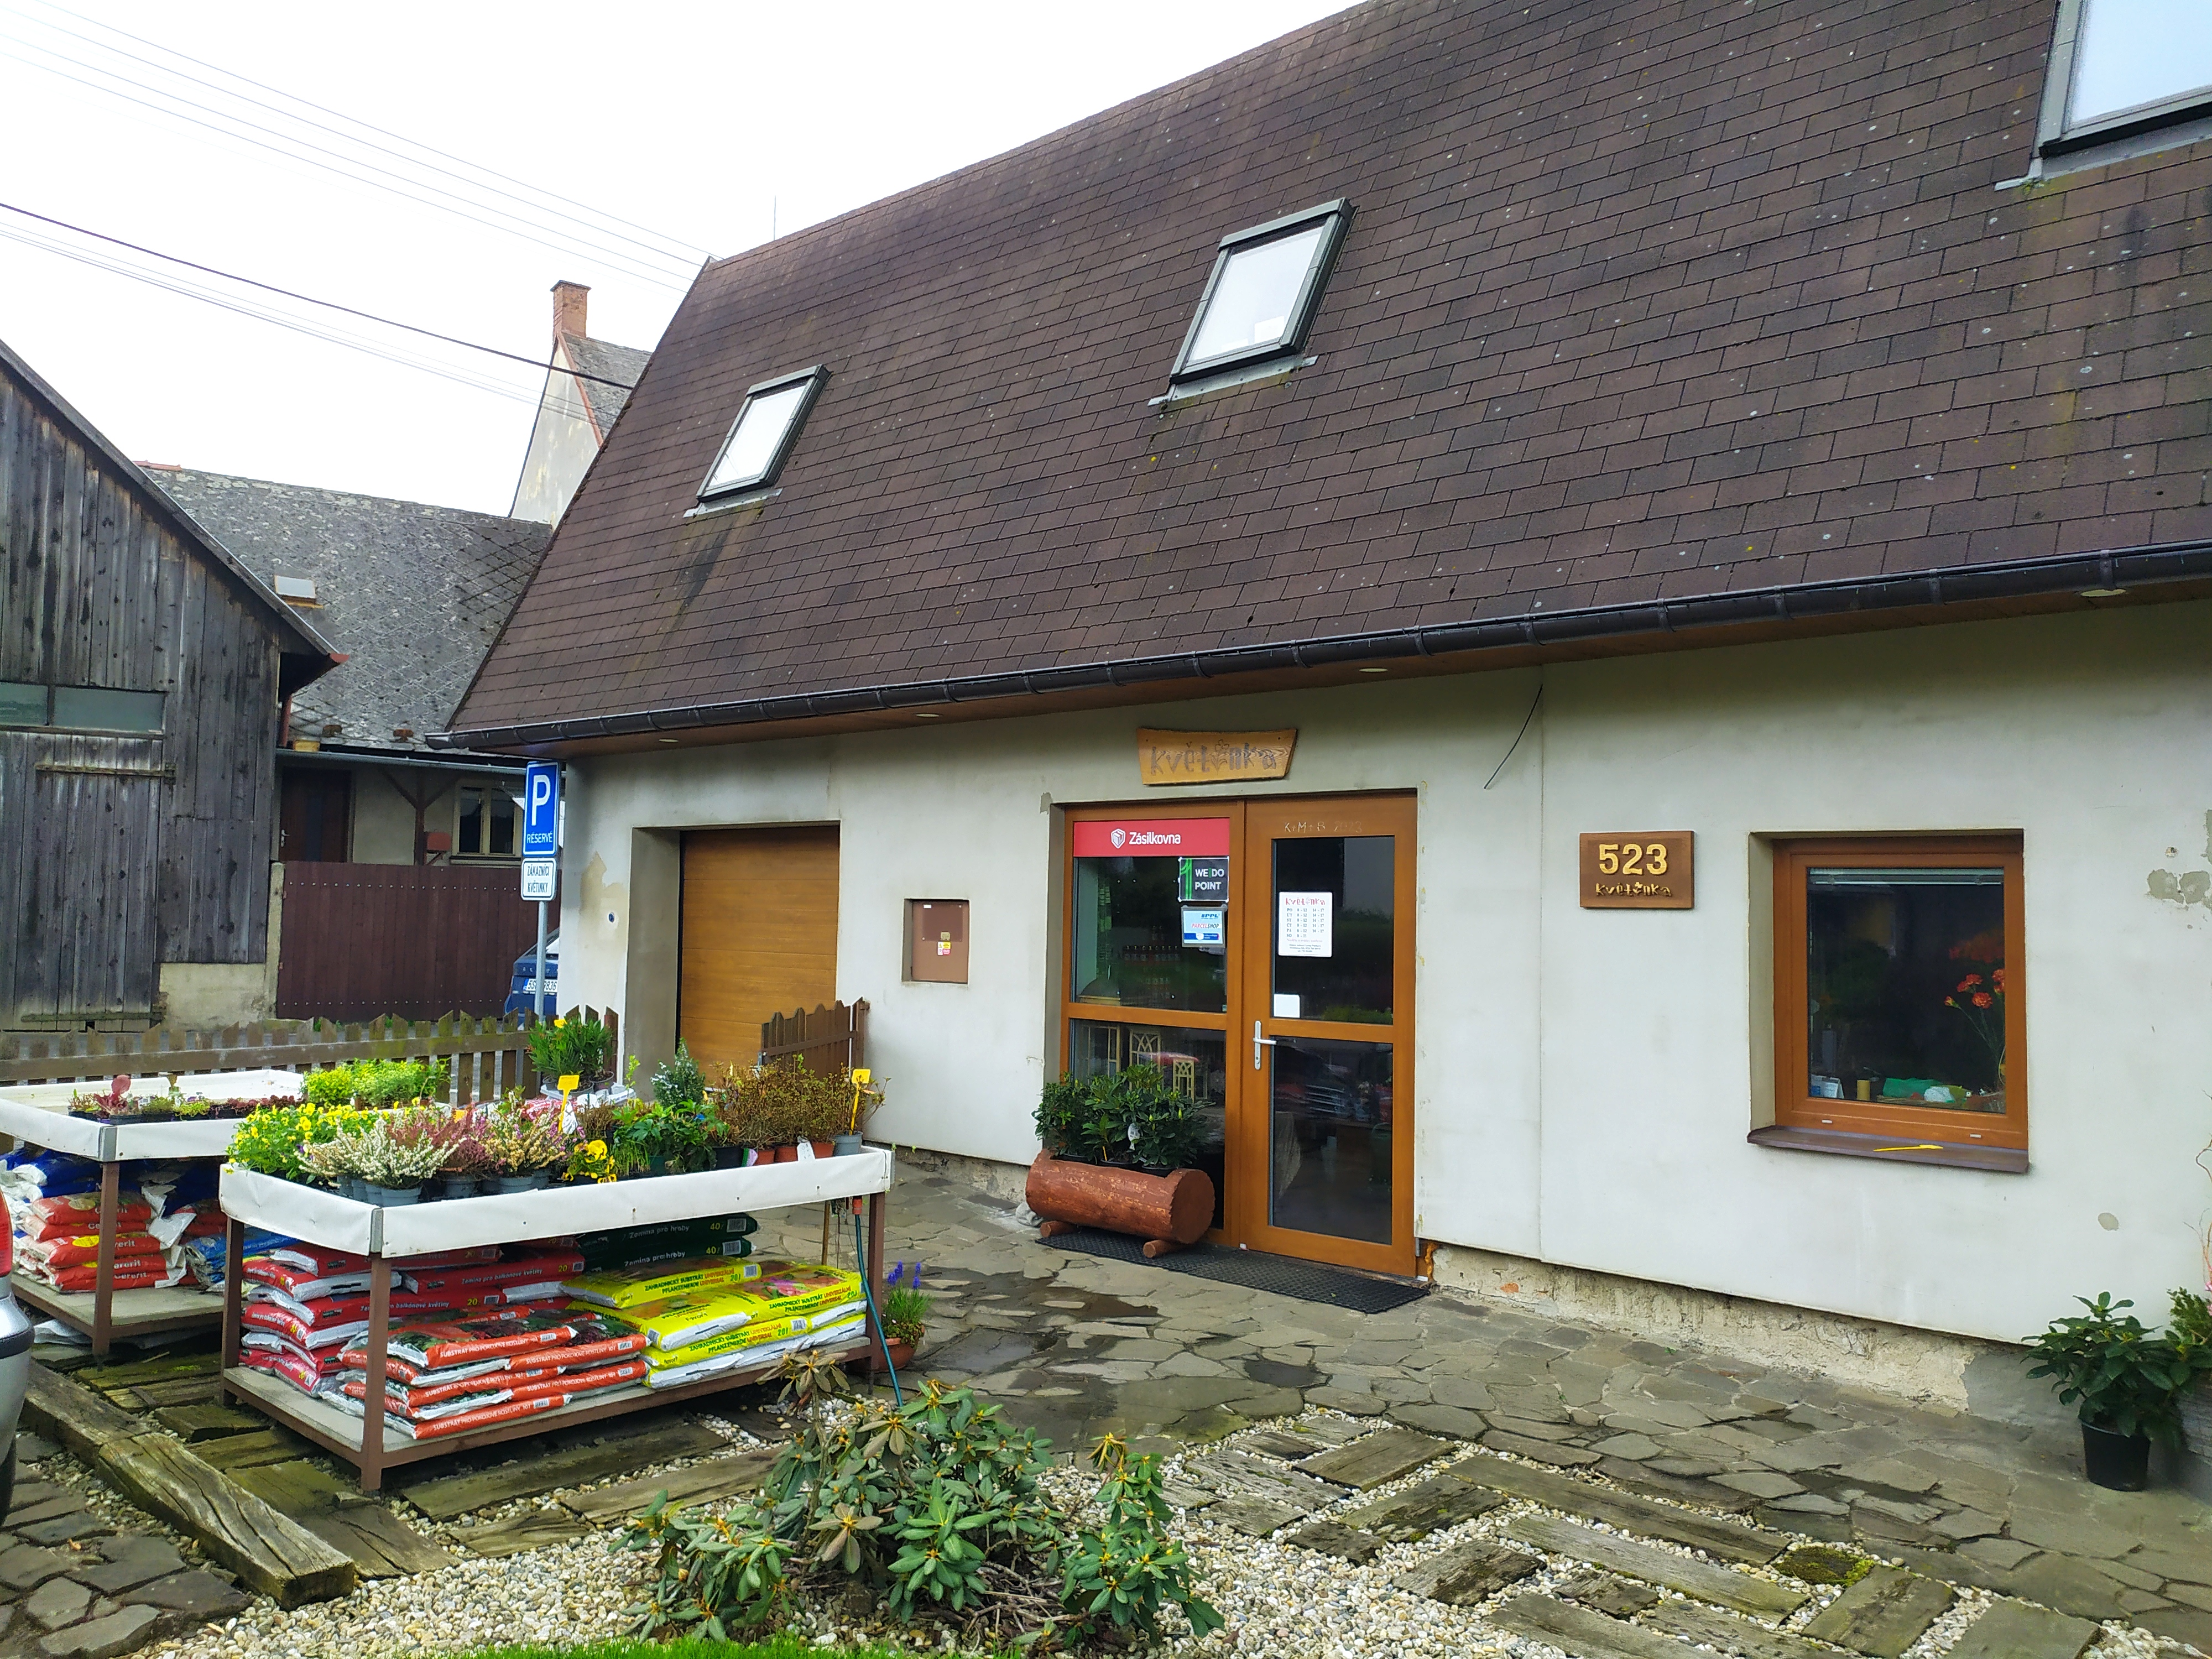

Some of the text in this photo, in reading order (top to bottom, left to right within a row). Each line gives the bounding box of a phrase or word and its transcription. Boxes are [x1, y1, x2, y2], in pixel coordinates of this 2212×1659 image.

[531, 775, 551, 826] P
[526, 831, 552, 843] RÉSERVÉ
[1129, 832, 1181, 845] Zásilkovna
[1599, 843, 1668, 875] 523
[527, 880, 548, 893] KVĚTINKY
[1194, 881, 1222, 890] POINT
[656, 1227, 668, 1235] pro
[670, 1224, 690, 1233] hroby
[653, 1254, 664, 1262] pro
[666, 1251, 686, 1259] hroby
[113, 1260, 141, 1269] ererit
[495, 1271, 522, 1280] balkónové
